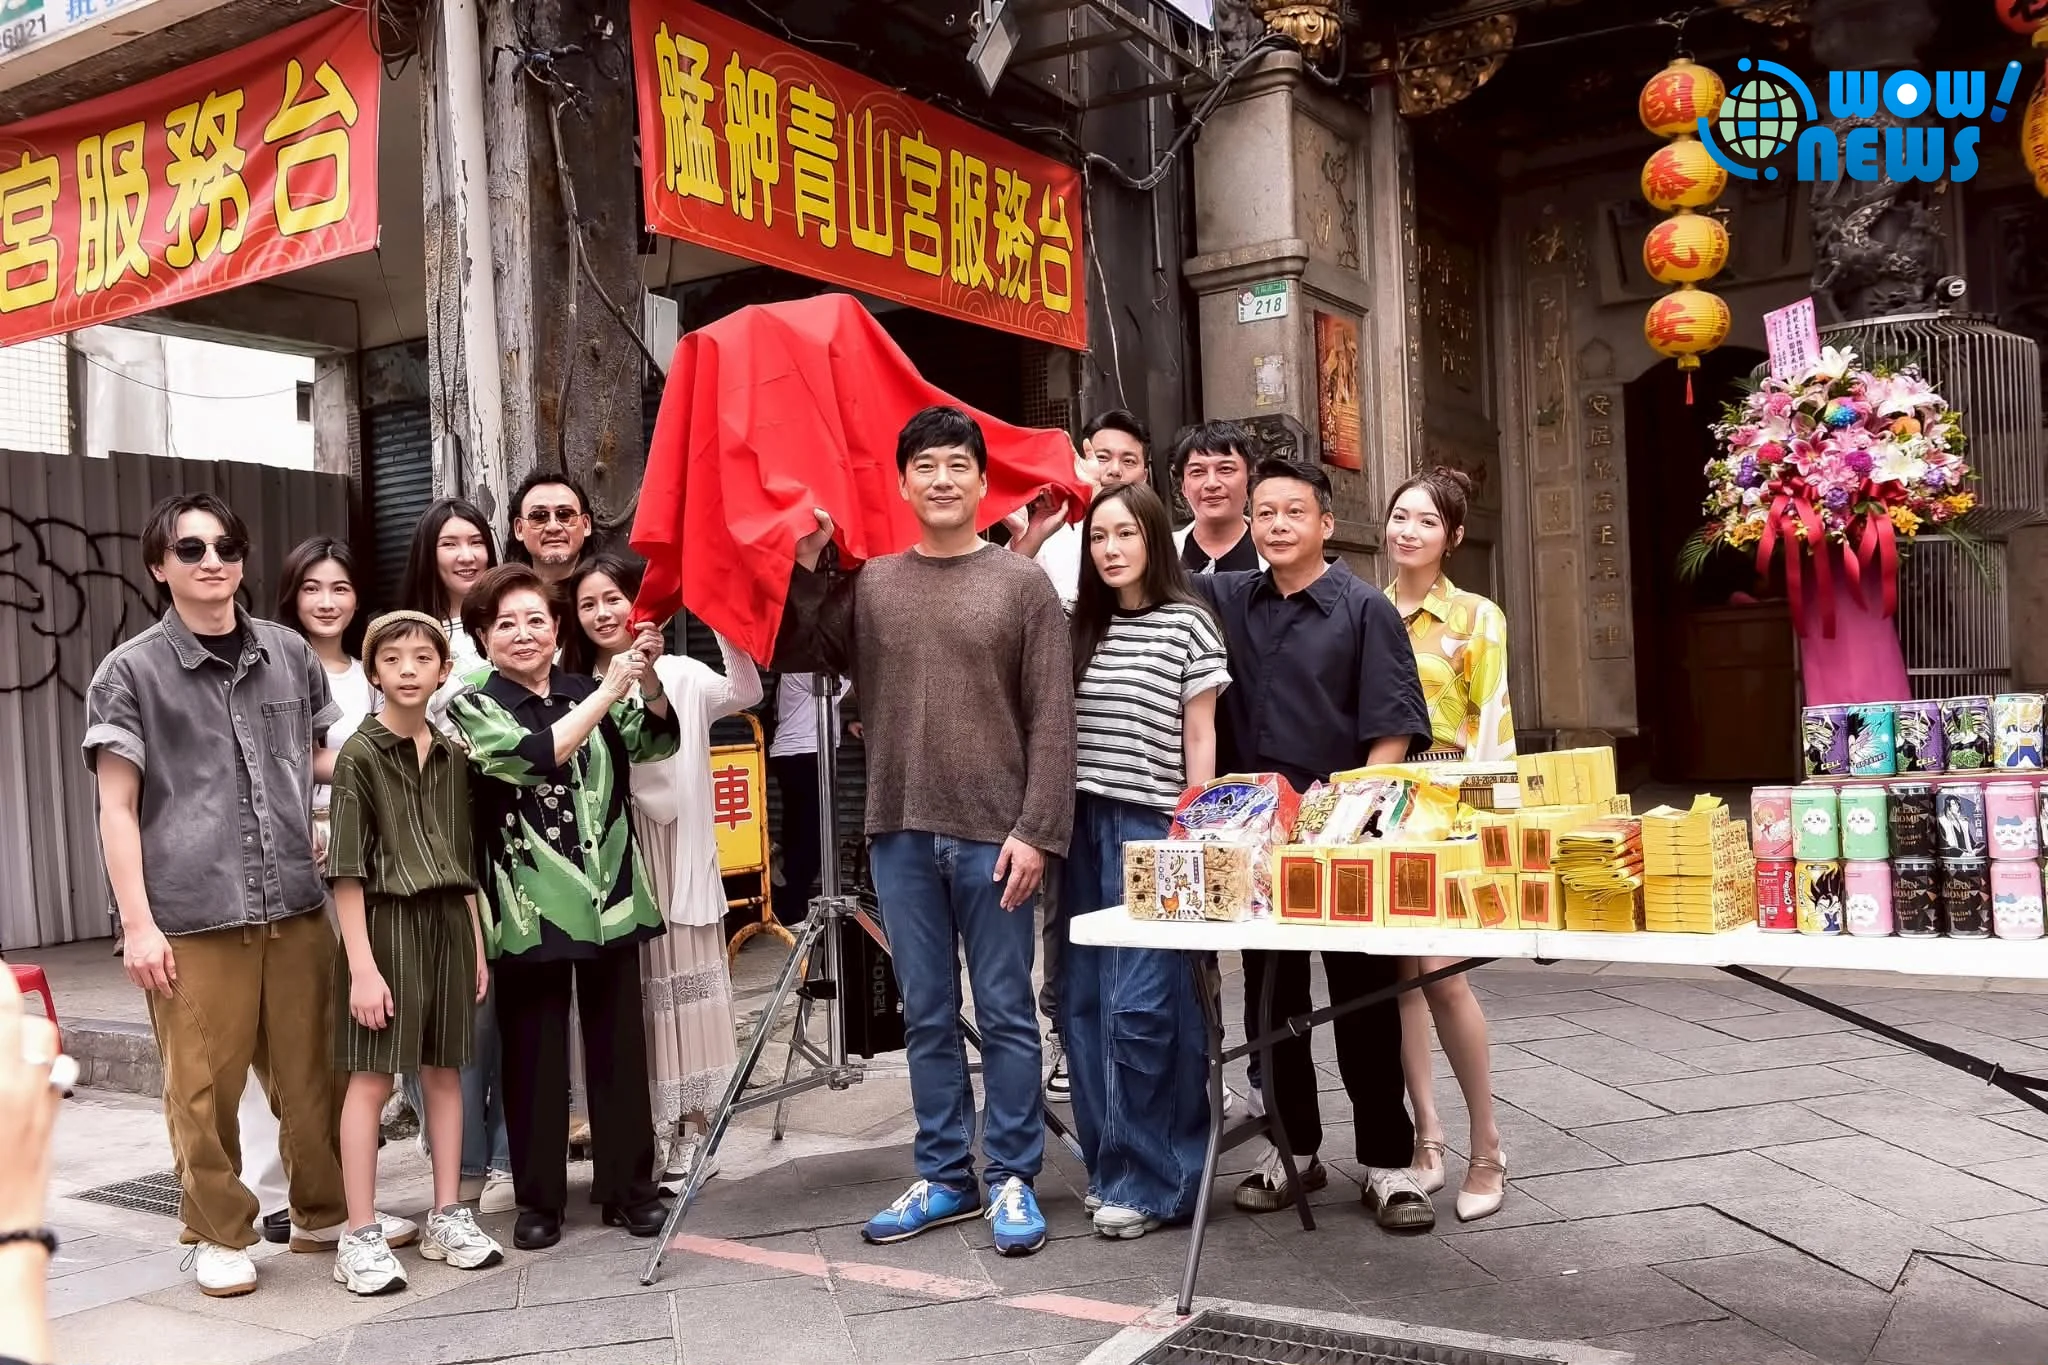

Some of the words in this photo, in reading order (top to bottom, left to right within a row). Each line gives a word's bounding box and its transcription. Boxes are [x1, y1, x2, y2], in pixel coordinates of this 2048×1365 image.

[0, 14, 46, 50] 6021
[0, 58, 359, 312] 宮服務台
[655, 21, 1073, 313] 艋舺青山宮服務台
[1255, 297, 1282, 315] 218
[712, 764, 753, 831] 車
